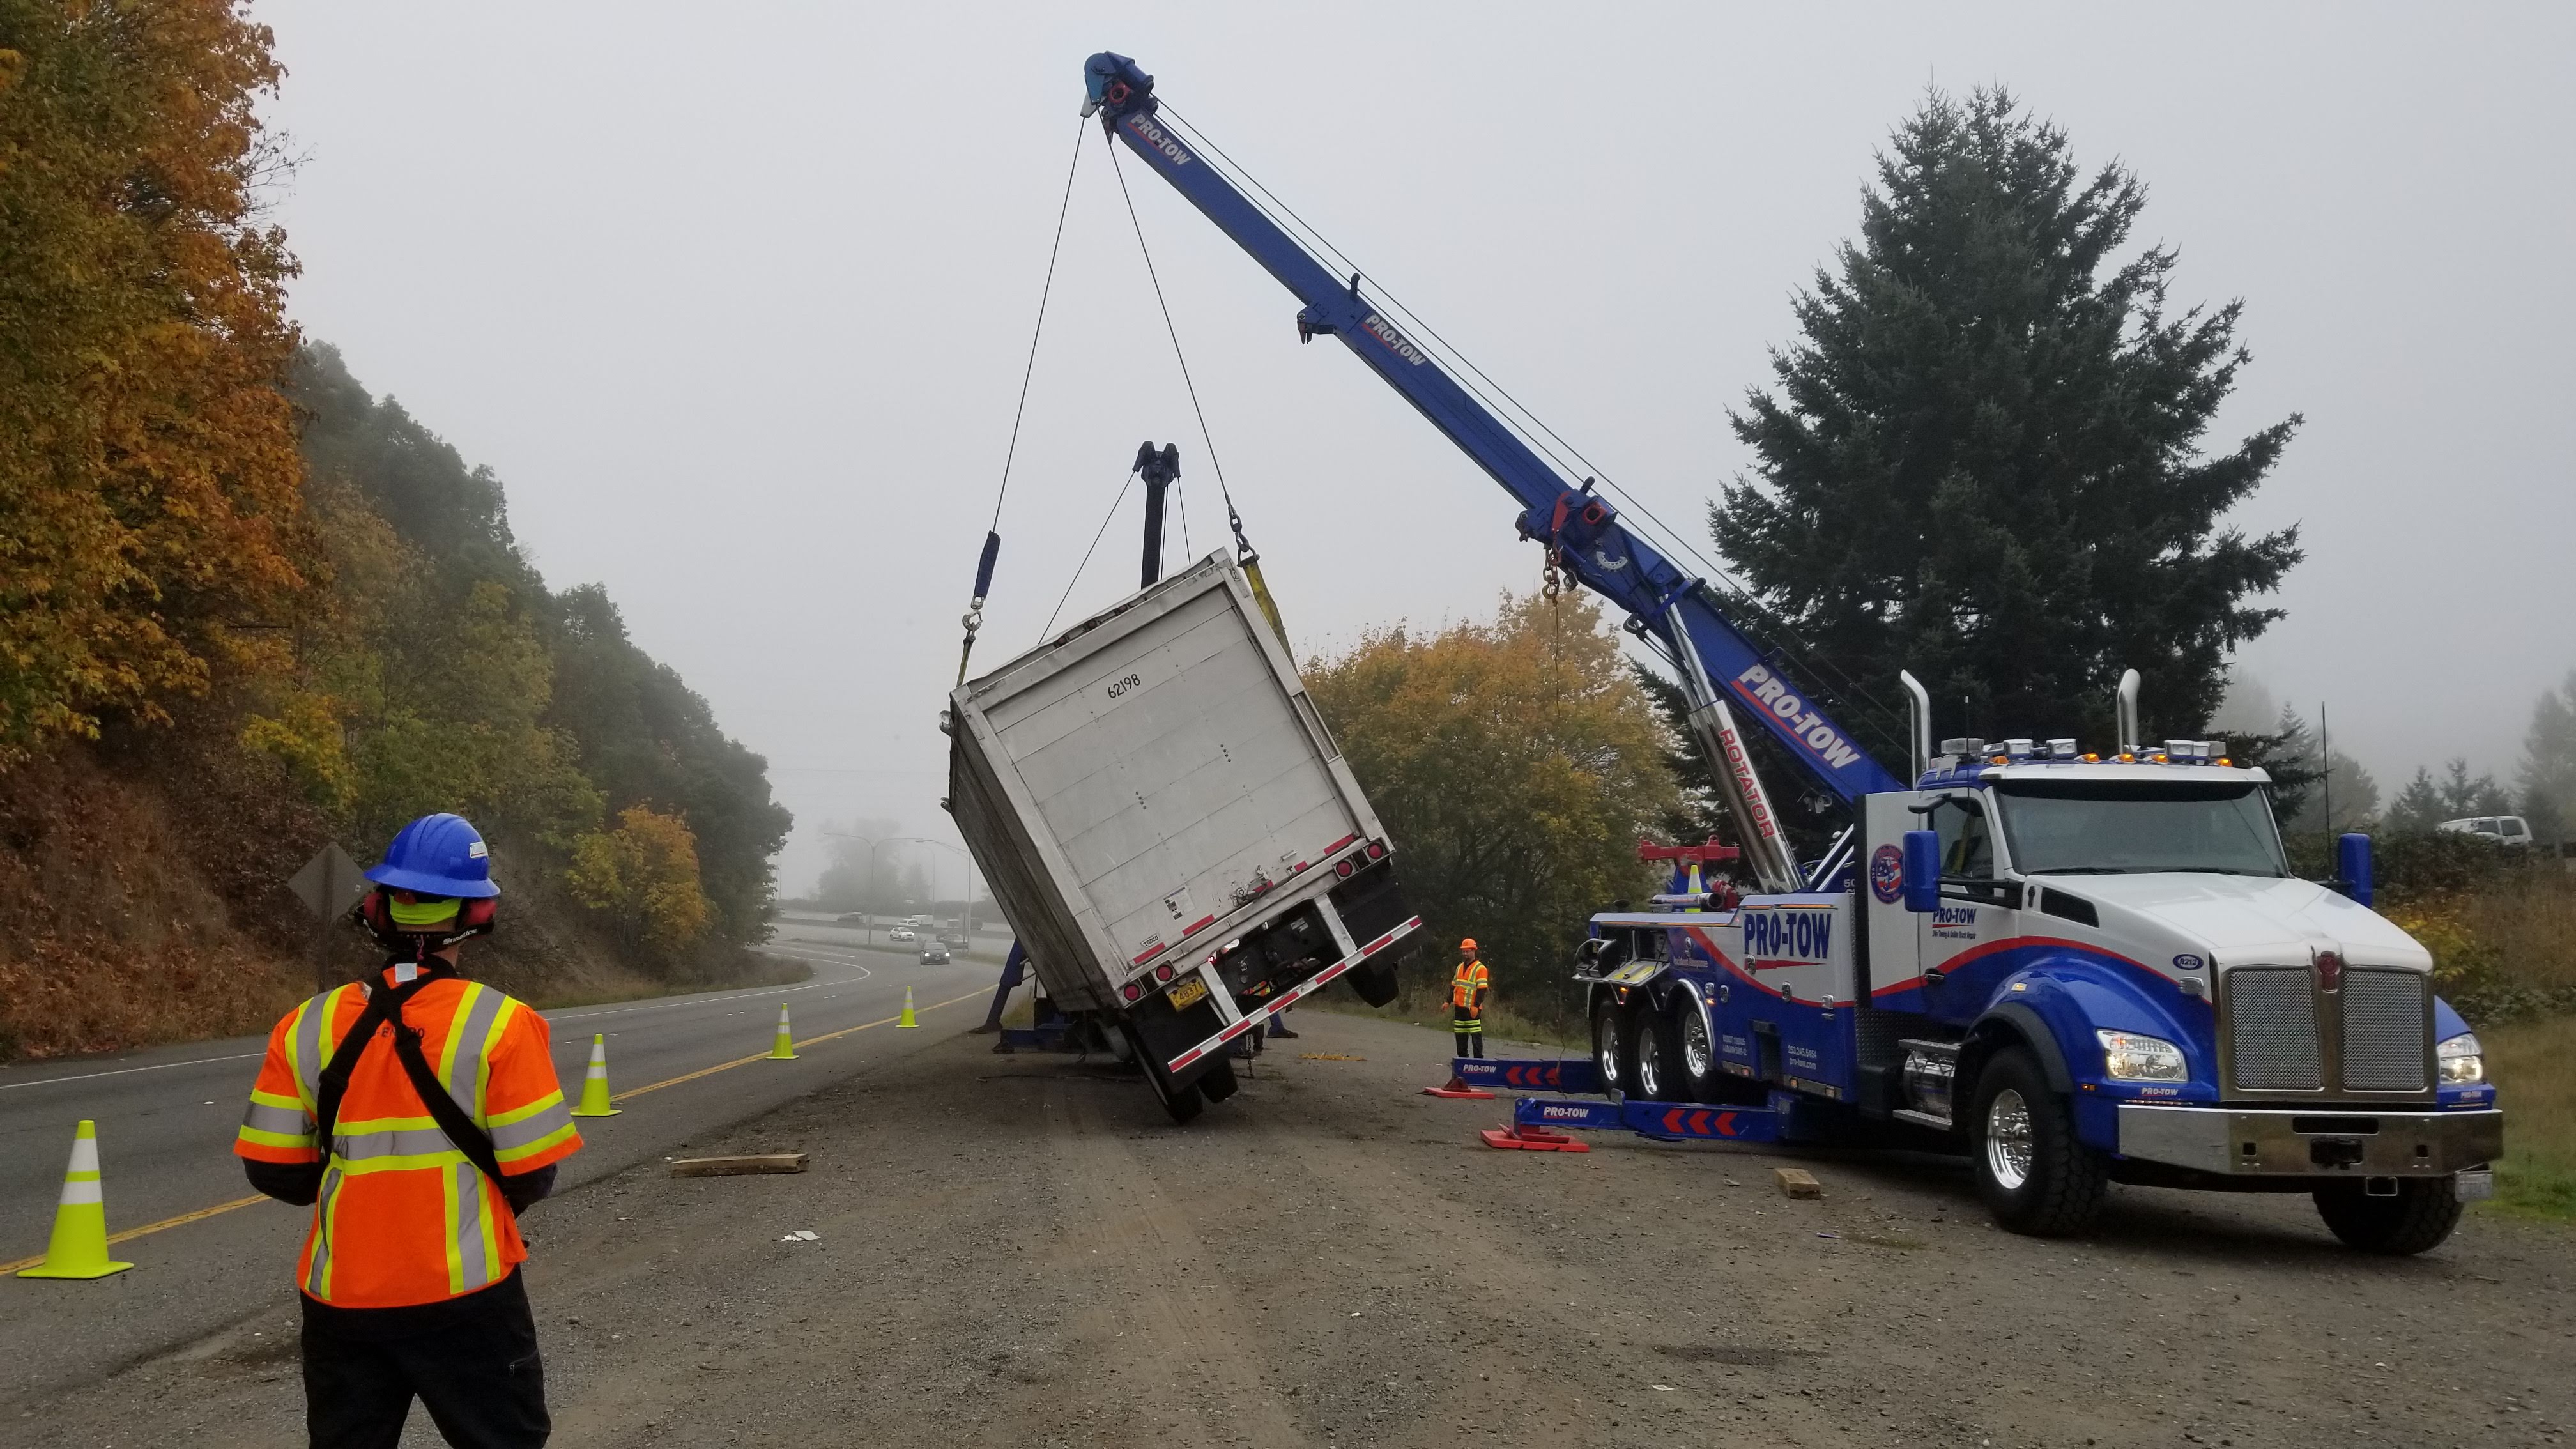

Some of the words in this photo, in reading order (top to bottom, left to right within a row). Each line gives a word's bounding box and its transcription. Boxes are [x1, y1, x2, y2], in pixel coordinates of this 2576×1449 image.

[1130, 114, 1192, 165] PRO-TOW
[1365, 314, 1427, 366] PRO-TOW
[1108, 673, 1141, 699] 62198
[1738, 663, 1861, 769] PRO-TOW
[1719, 728, 1776, 839] ROTATOR
[1933, 907, 1977, 924] PRO-TOW
[1744, 912, 1832, 959] PRO-TOW
[1463, 1064, 1497, 1073] PRO-TOW
[2142, 1087, 2179, 1096] PRO-TOW
[1544, 1106, 1590, 1118] PRO-TOW
